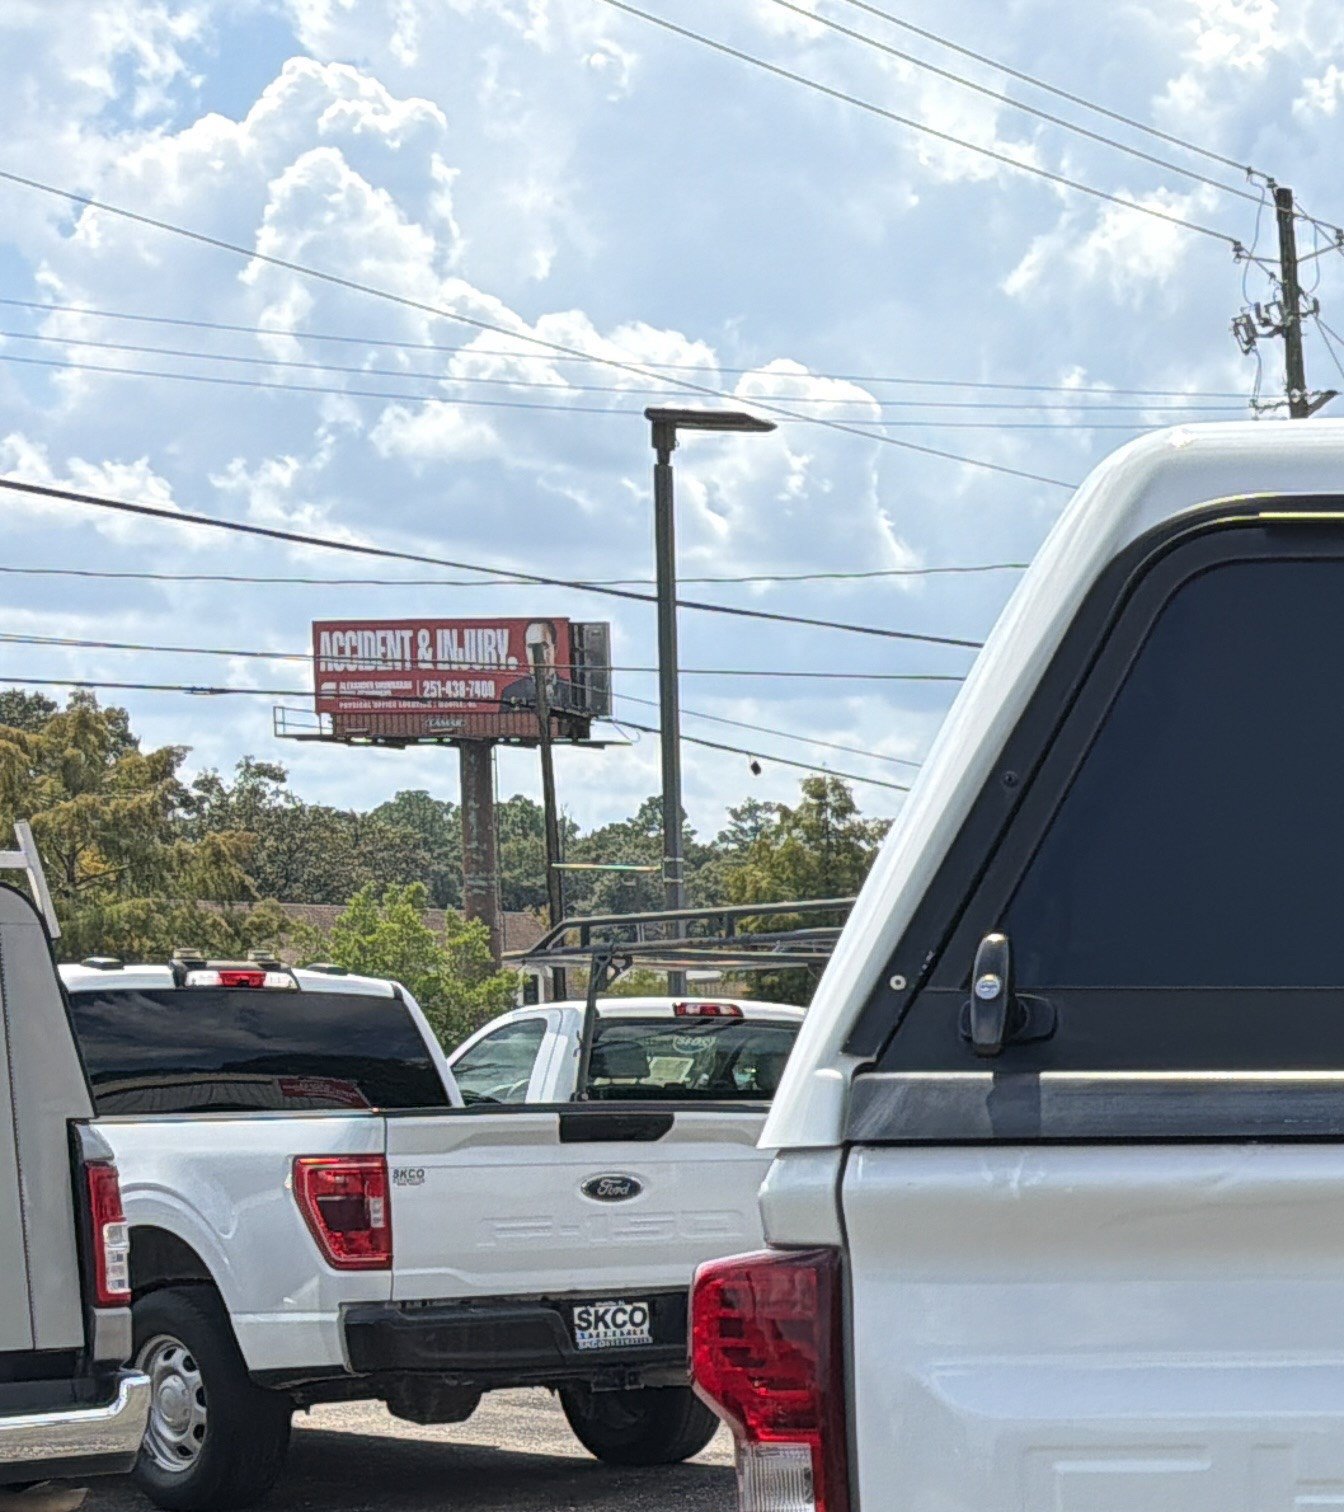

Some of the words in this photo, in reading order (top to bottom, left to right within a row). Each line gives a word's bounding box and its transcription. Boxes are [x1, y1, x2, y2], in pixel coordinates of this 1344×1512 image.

[320, 630, 413, 672] ACCIDENT
[417, 629, 433, 670] &
[436, 628, 518, 671] INJURY.
[597, 1178, 631, 1196] Ford
[477, 1209, 743, 1246] F-150
[574, 1305, 648, 1330] SKCO
